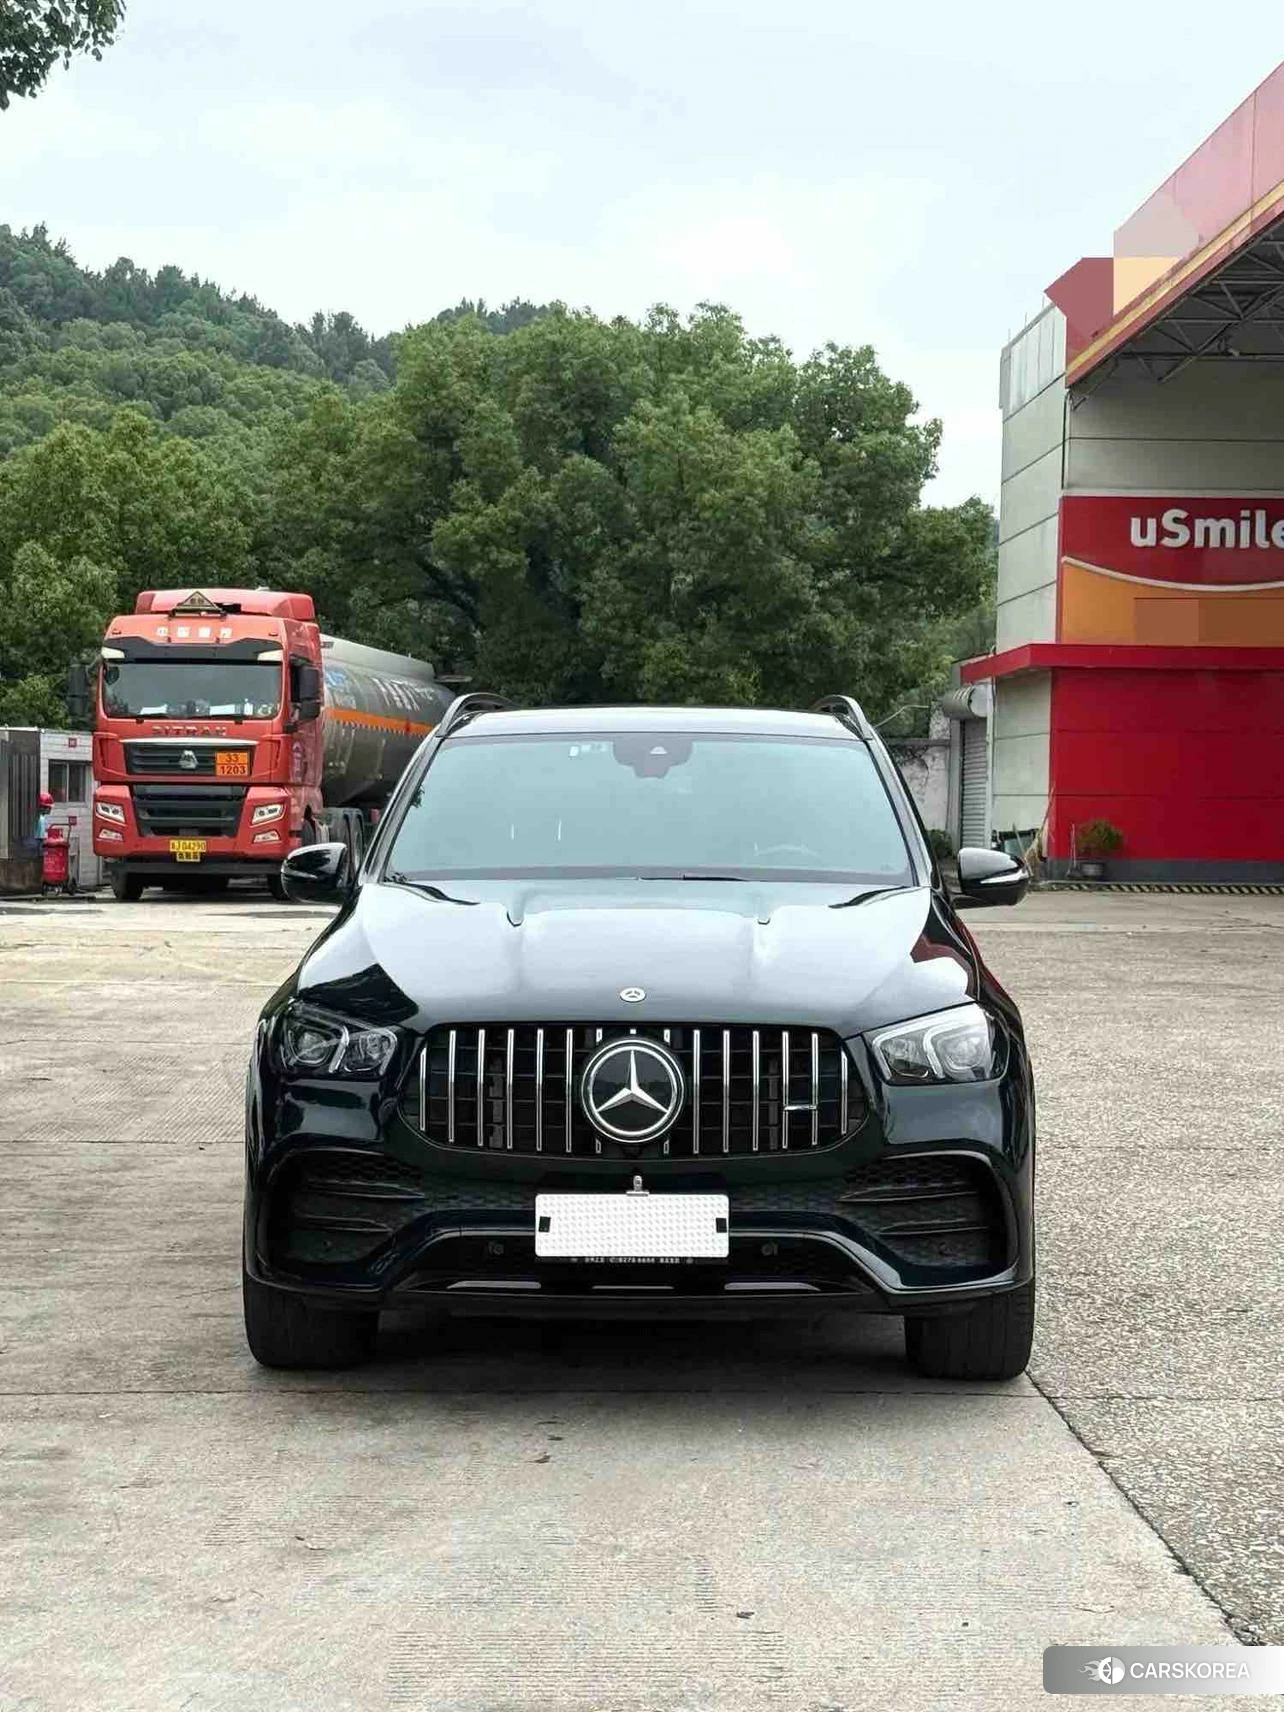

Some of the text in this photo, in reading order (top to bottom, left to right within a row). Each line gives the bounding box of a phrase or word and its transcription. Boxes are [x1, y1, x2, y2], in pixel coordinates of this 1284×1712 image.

[1130, 509, 1284, 549] uSmile
[225, 753, 239, 763] 33
[220, 765, 247, 775] 1203
